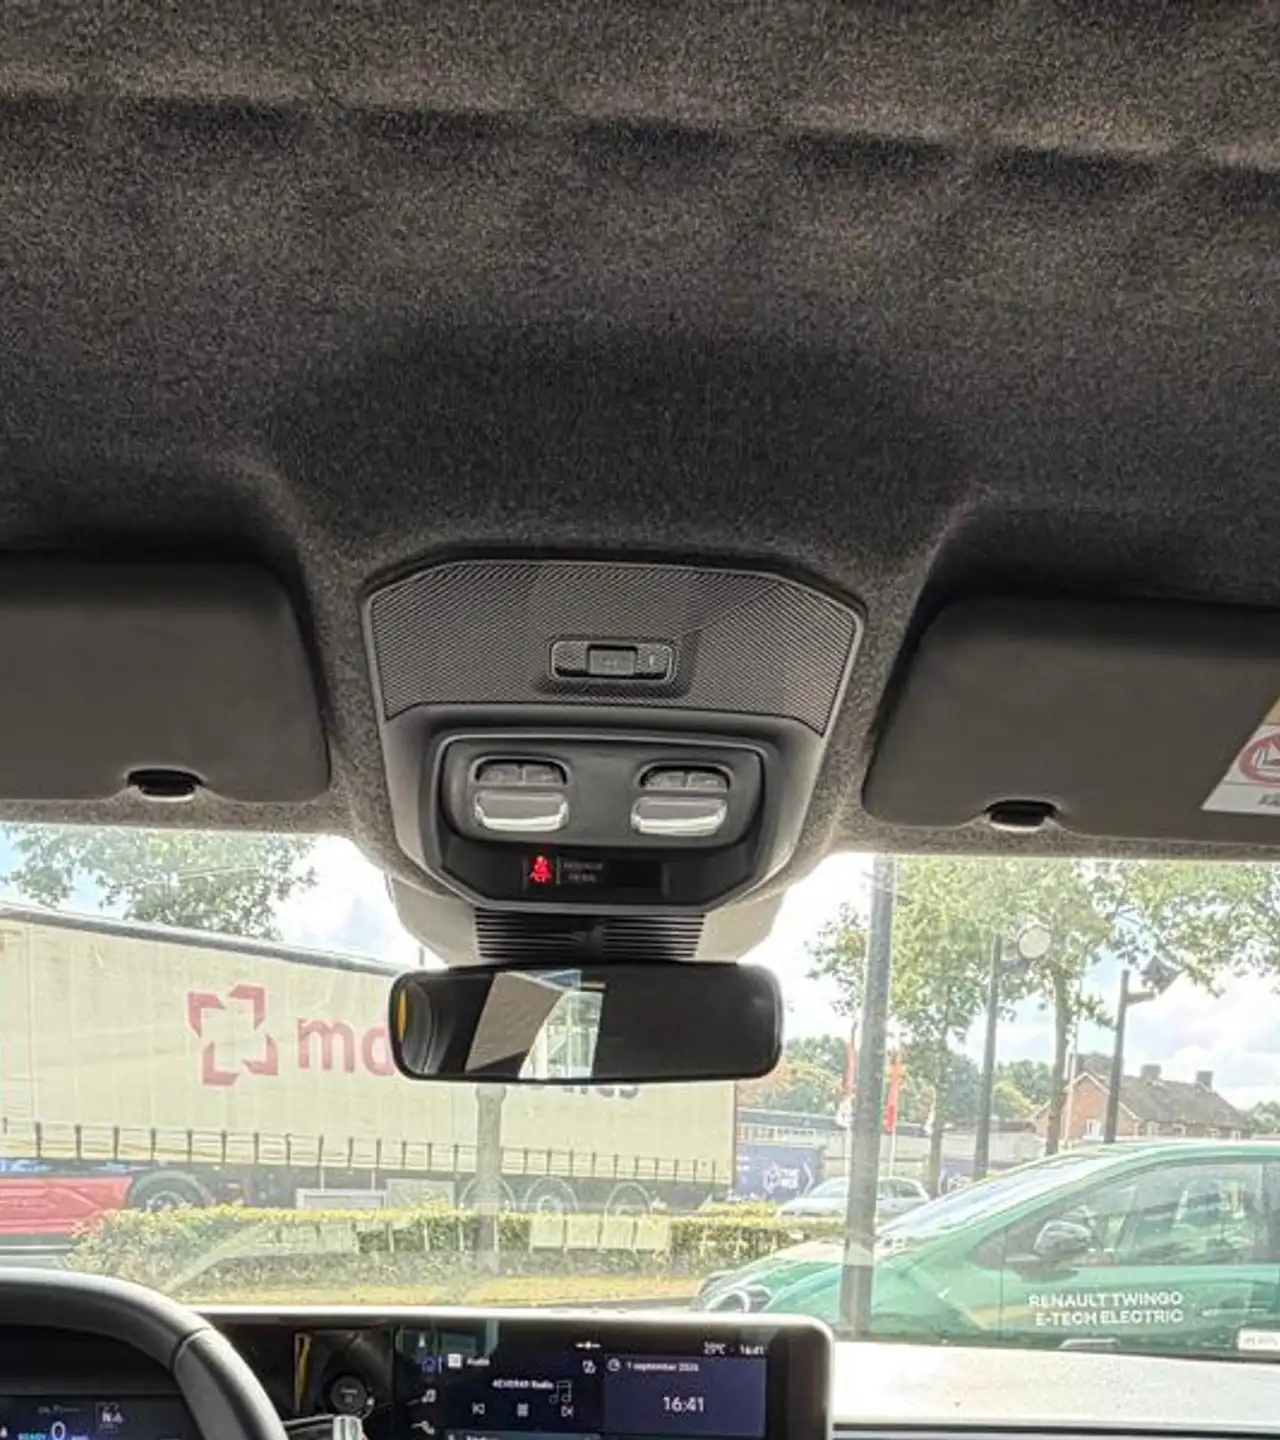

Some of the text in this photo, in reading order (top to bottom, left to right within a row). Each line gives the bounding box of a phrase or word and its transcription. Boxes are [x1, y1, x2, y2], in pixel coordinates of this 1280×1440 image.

[1028, 1290, 1184, 1307] RENAULT TWINGO
[1035, 1308, 1185, 1327] E-TECH ELECTRIC
[663, 1396, 705, 1413] 16:41
[51, 1420, 66, 1440] 0
